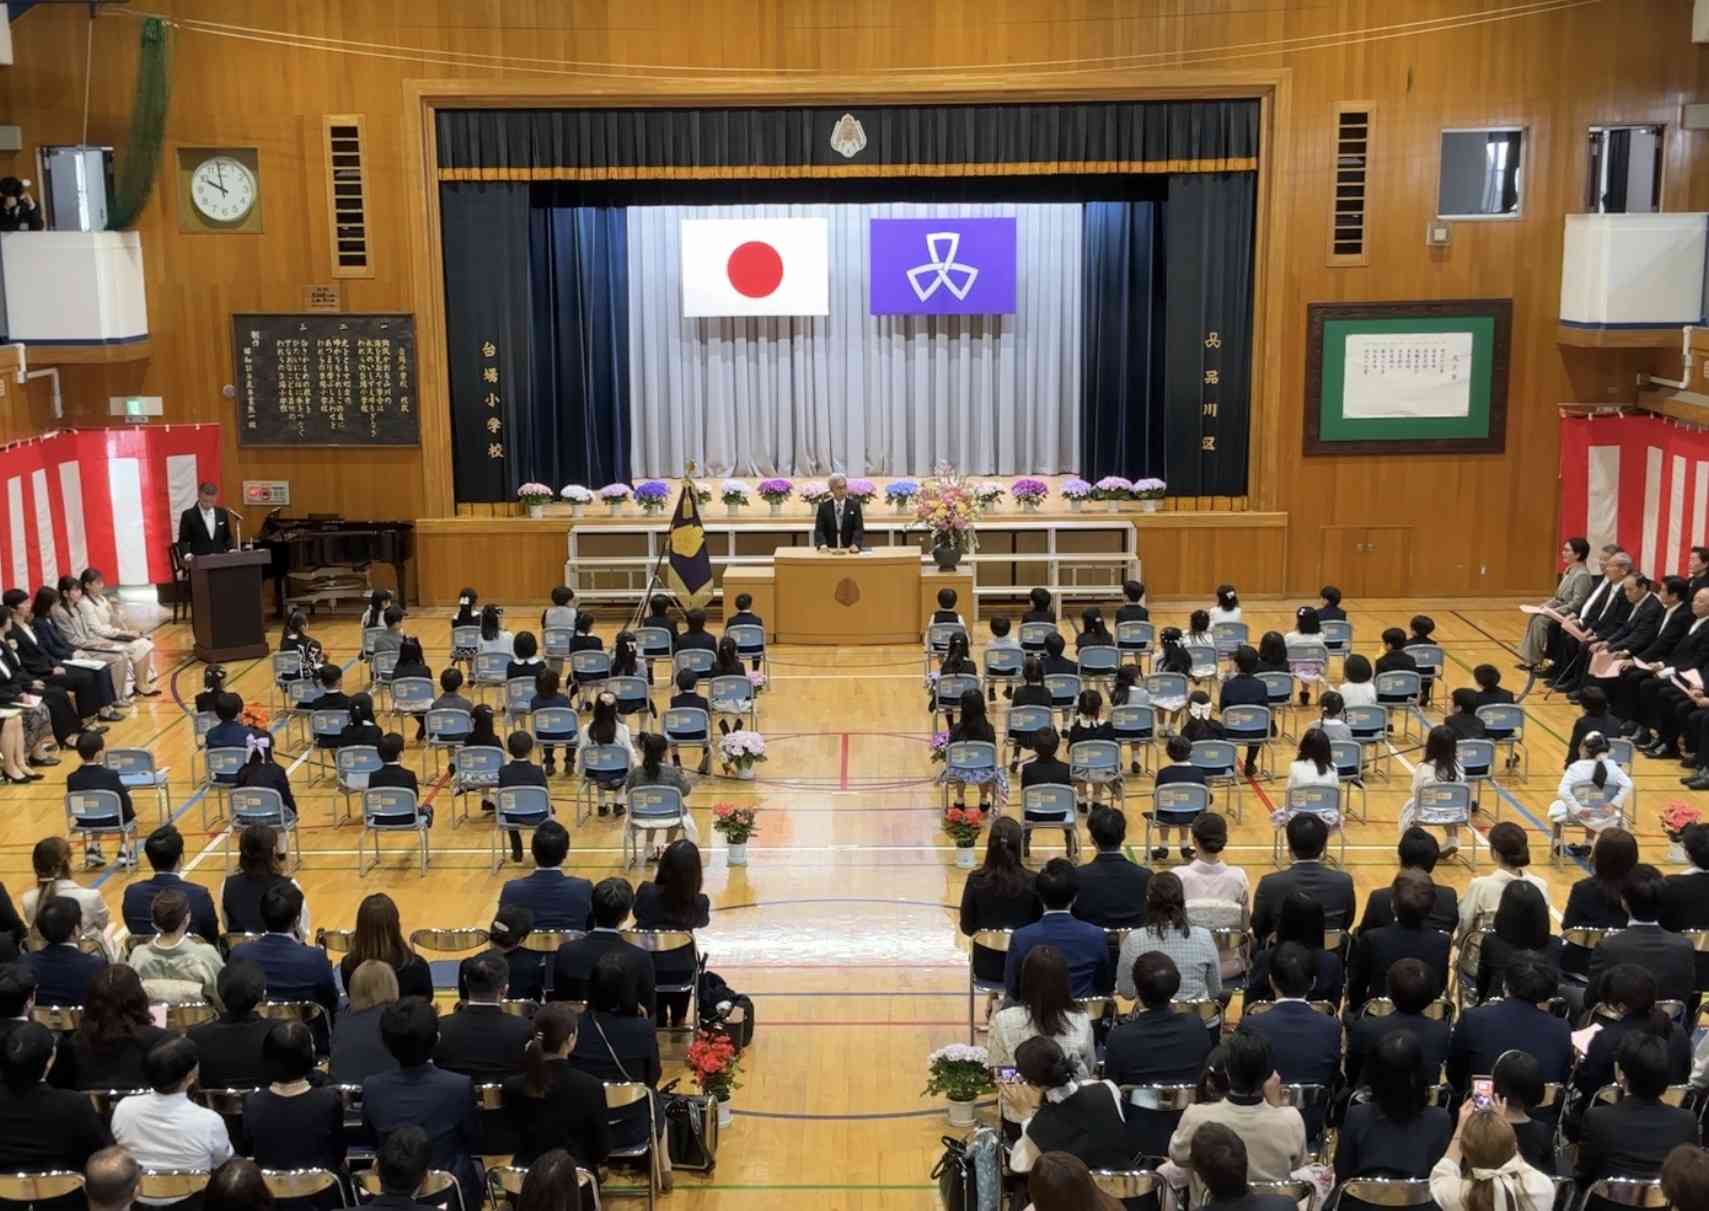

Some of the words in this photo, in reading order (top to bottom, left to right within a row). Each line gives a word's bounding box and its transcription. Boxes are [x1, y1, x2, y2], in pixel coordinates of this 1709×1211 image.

[482, 341, 504, 458] 台場小学校
[1202, 370, 1219, 451] 品川区
